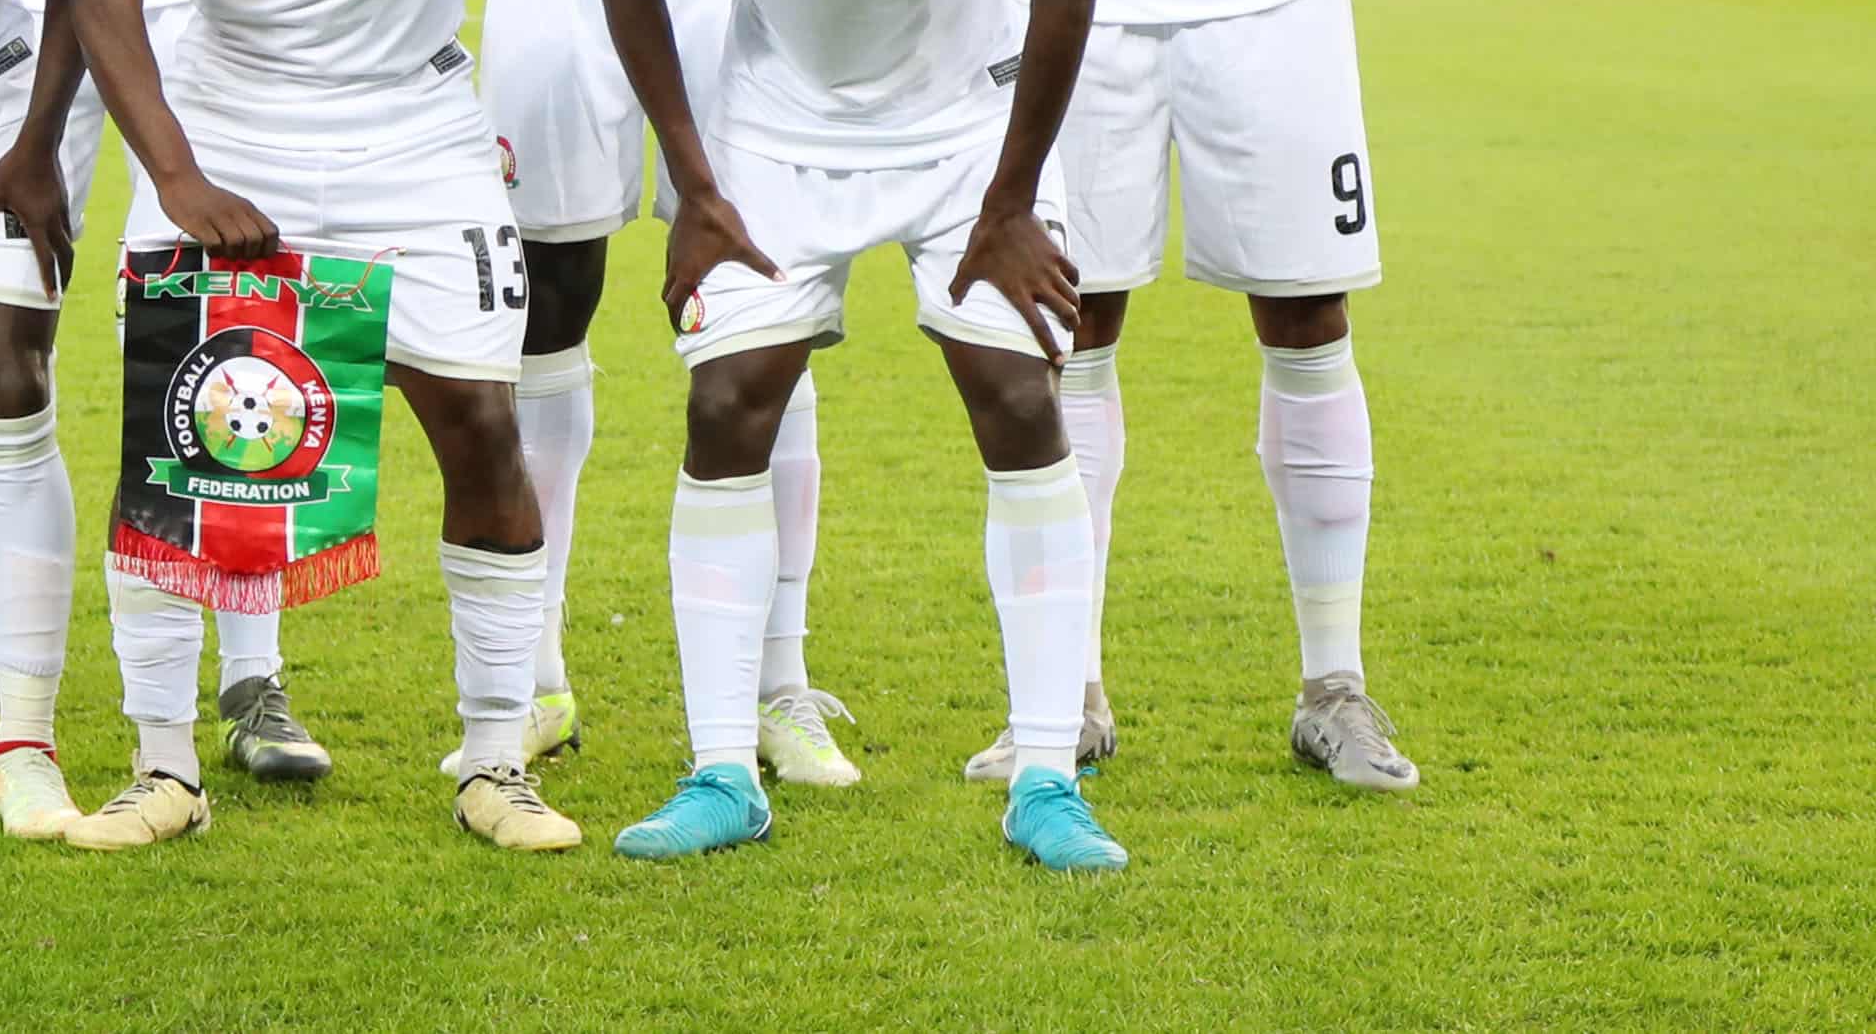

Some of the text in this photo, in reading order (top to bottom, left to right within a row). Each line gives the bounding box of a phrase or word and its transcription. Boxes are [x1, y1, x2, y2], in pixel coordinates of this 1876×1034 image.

[1331, 152, 1366, 236] 9
[143, 270, 373, 312] KENYA
[462, 225, 526, 312] 13
[174, 352, 215, 459] FOOTBALL
[301, 379, 327, 449] KENYA
[187, 476, 311, 501] FEDERATION
